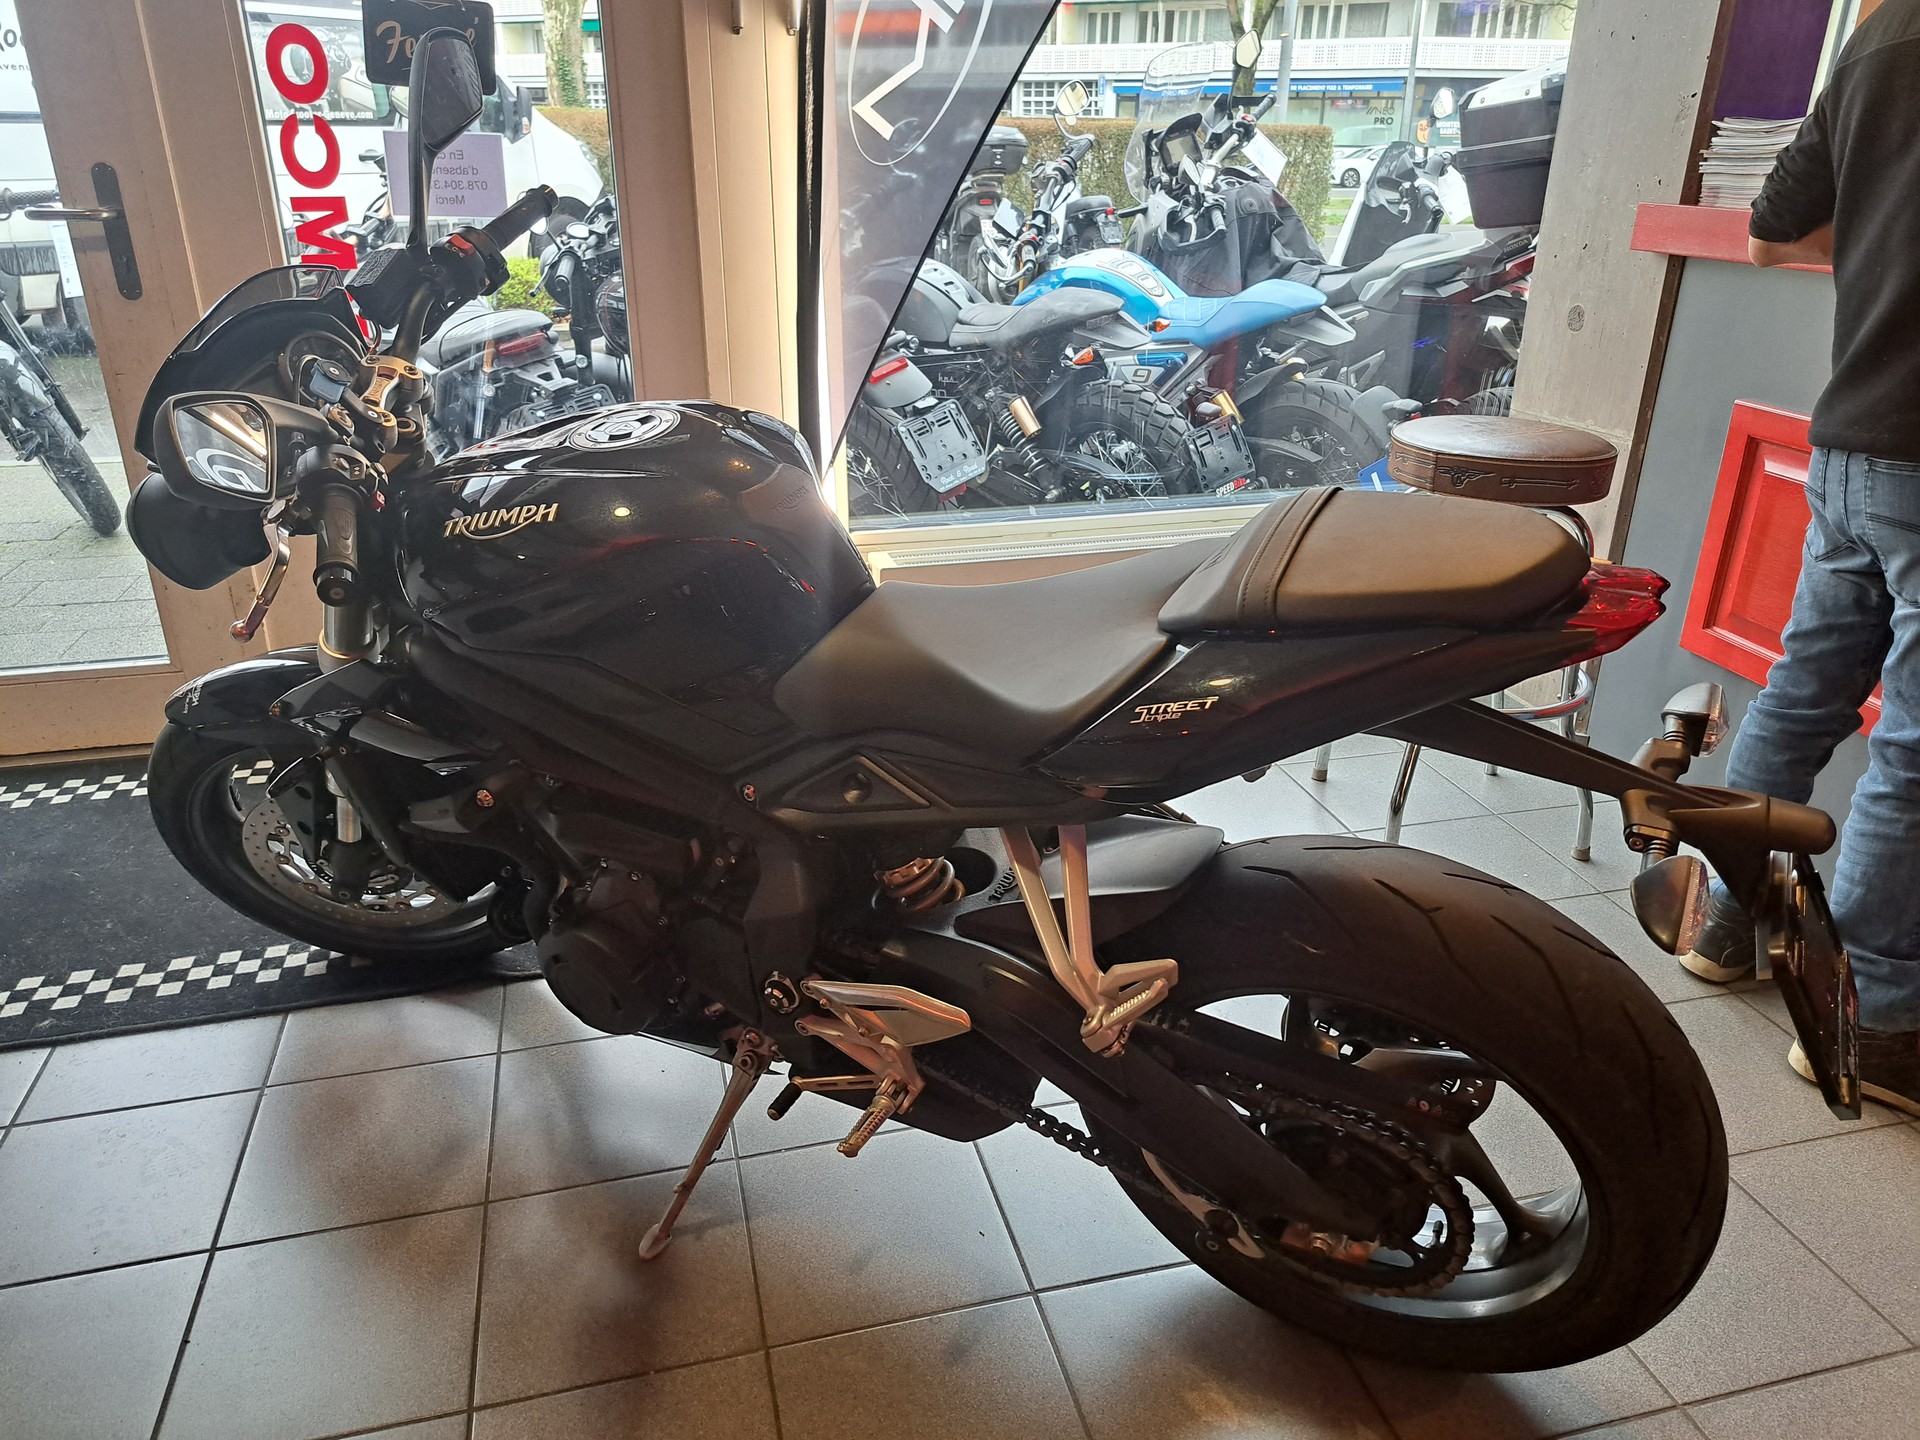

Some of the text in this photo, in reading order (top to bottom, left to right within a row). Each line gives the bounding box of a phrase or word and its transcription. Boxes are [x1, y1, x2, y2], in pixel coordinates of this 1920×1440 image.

[376, 16, 480, 64] Feé
[1374, 117, 1393, 125] PRO
[1503, 239, 1529, 252] HONDA
[771, 485, 808, 511] TRIUMPH
[443, 503, 559, 540] TRIUMPH
[1130, 696, 1219, 723] STREET
[1144, 712, 1182, 722] triple
